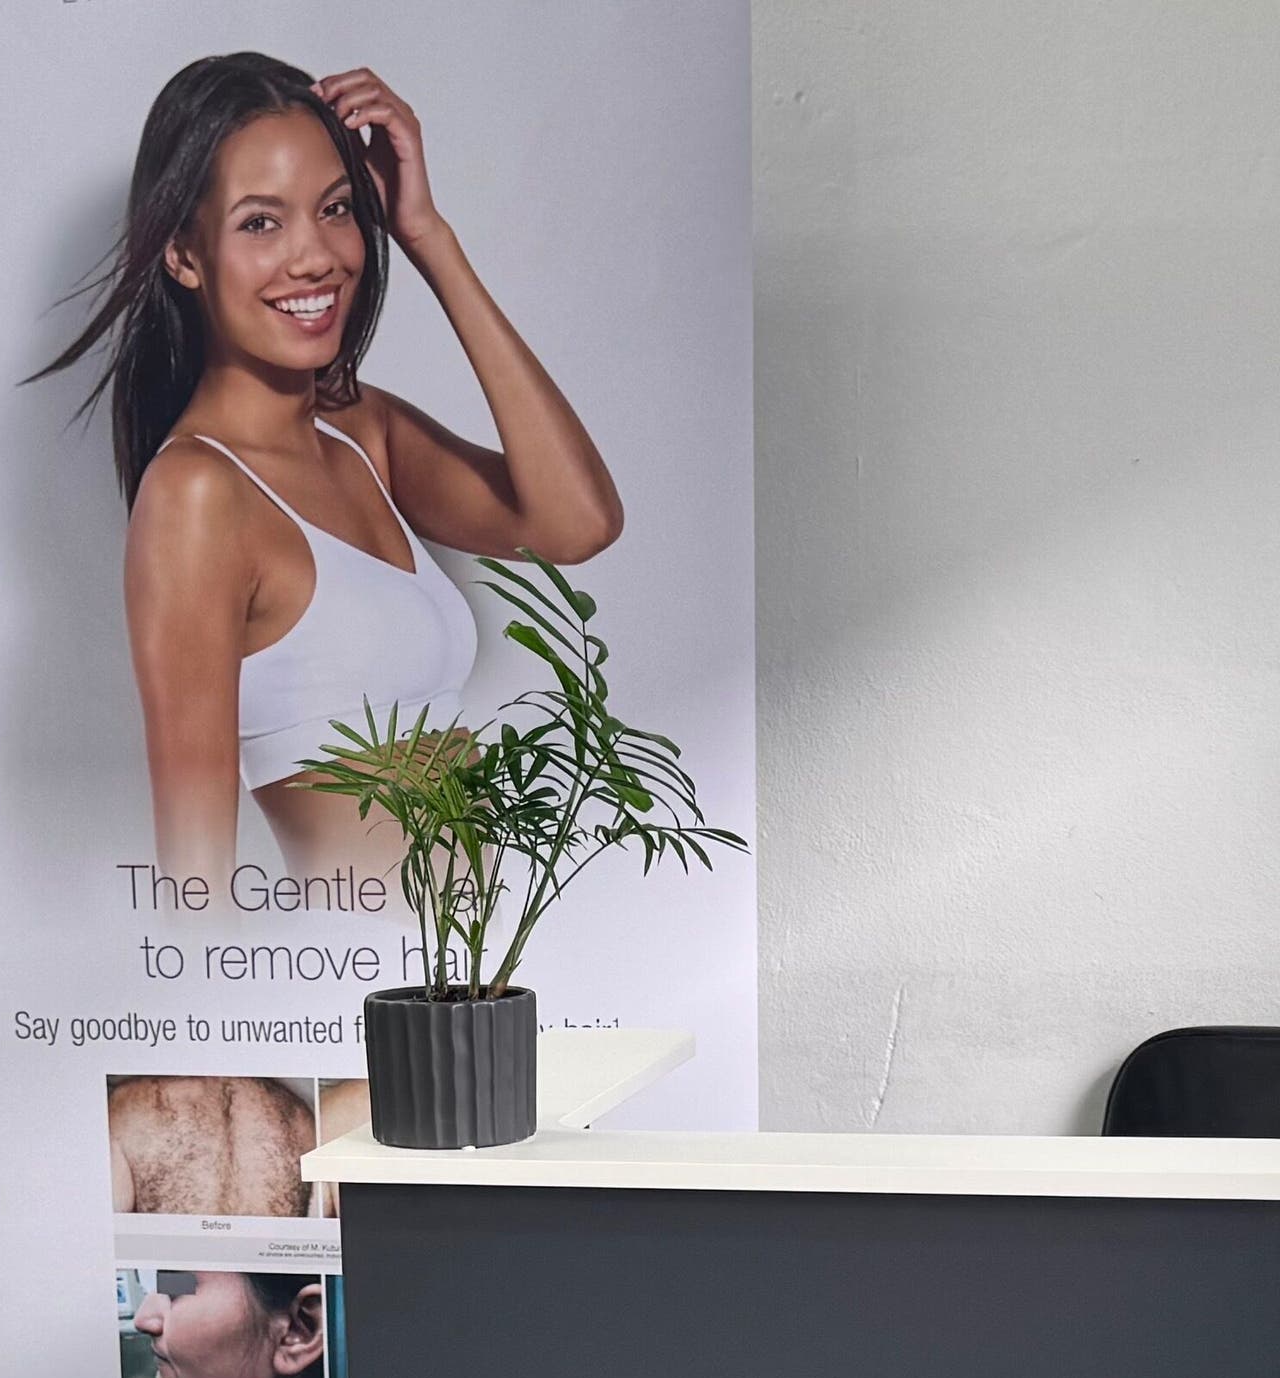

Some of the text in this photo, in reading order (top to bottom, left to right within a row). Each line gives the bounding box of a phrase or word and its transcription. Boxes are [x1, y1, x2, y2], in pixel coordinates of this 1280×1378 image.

[116, 864, 387, 912] The Gentle
[140, 935, 488, 981] to remove hai
[15, 1011, 60, 1046] Say
[70, 1012, 176, 1047] goodbye
[186, 1014, 210, 1042] to
[222, 1015, 343, 1044] unwanted
[201, 1220, 232, 1231] Before
